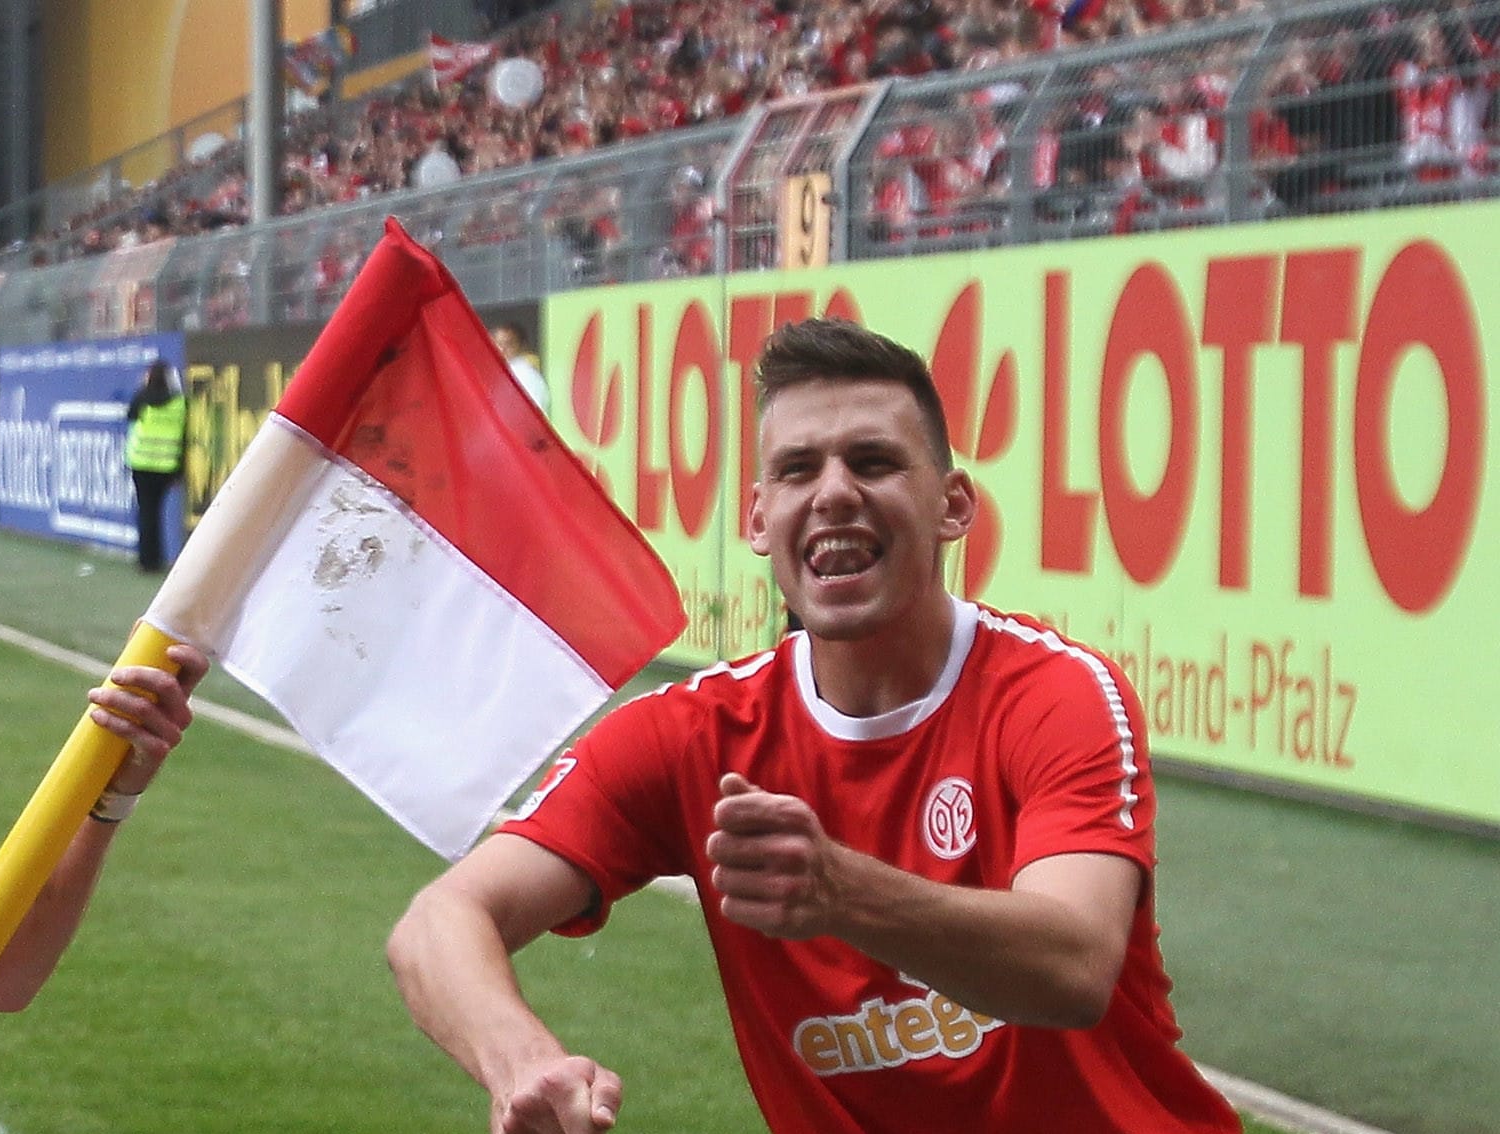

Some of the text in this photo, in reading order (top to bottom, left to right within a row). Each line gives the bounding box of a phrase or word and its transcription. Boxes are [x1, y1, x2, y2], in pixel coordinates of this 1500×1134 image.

[635, 287, 864, 541] LOT
[1041, 238, 1487, 616] LOTTO
[799, 993, 994, 1071] enteg
